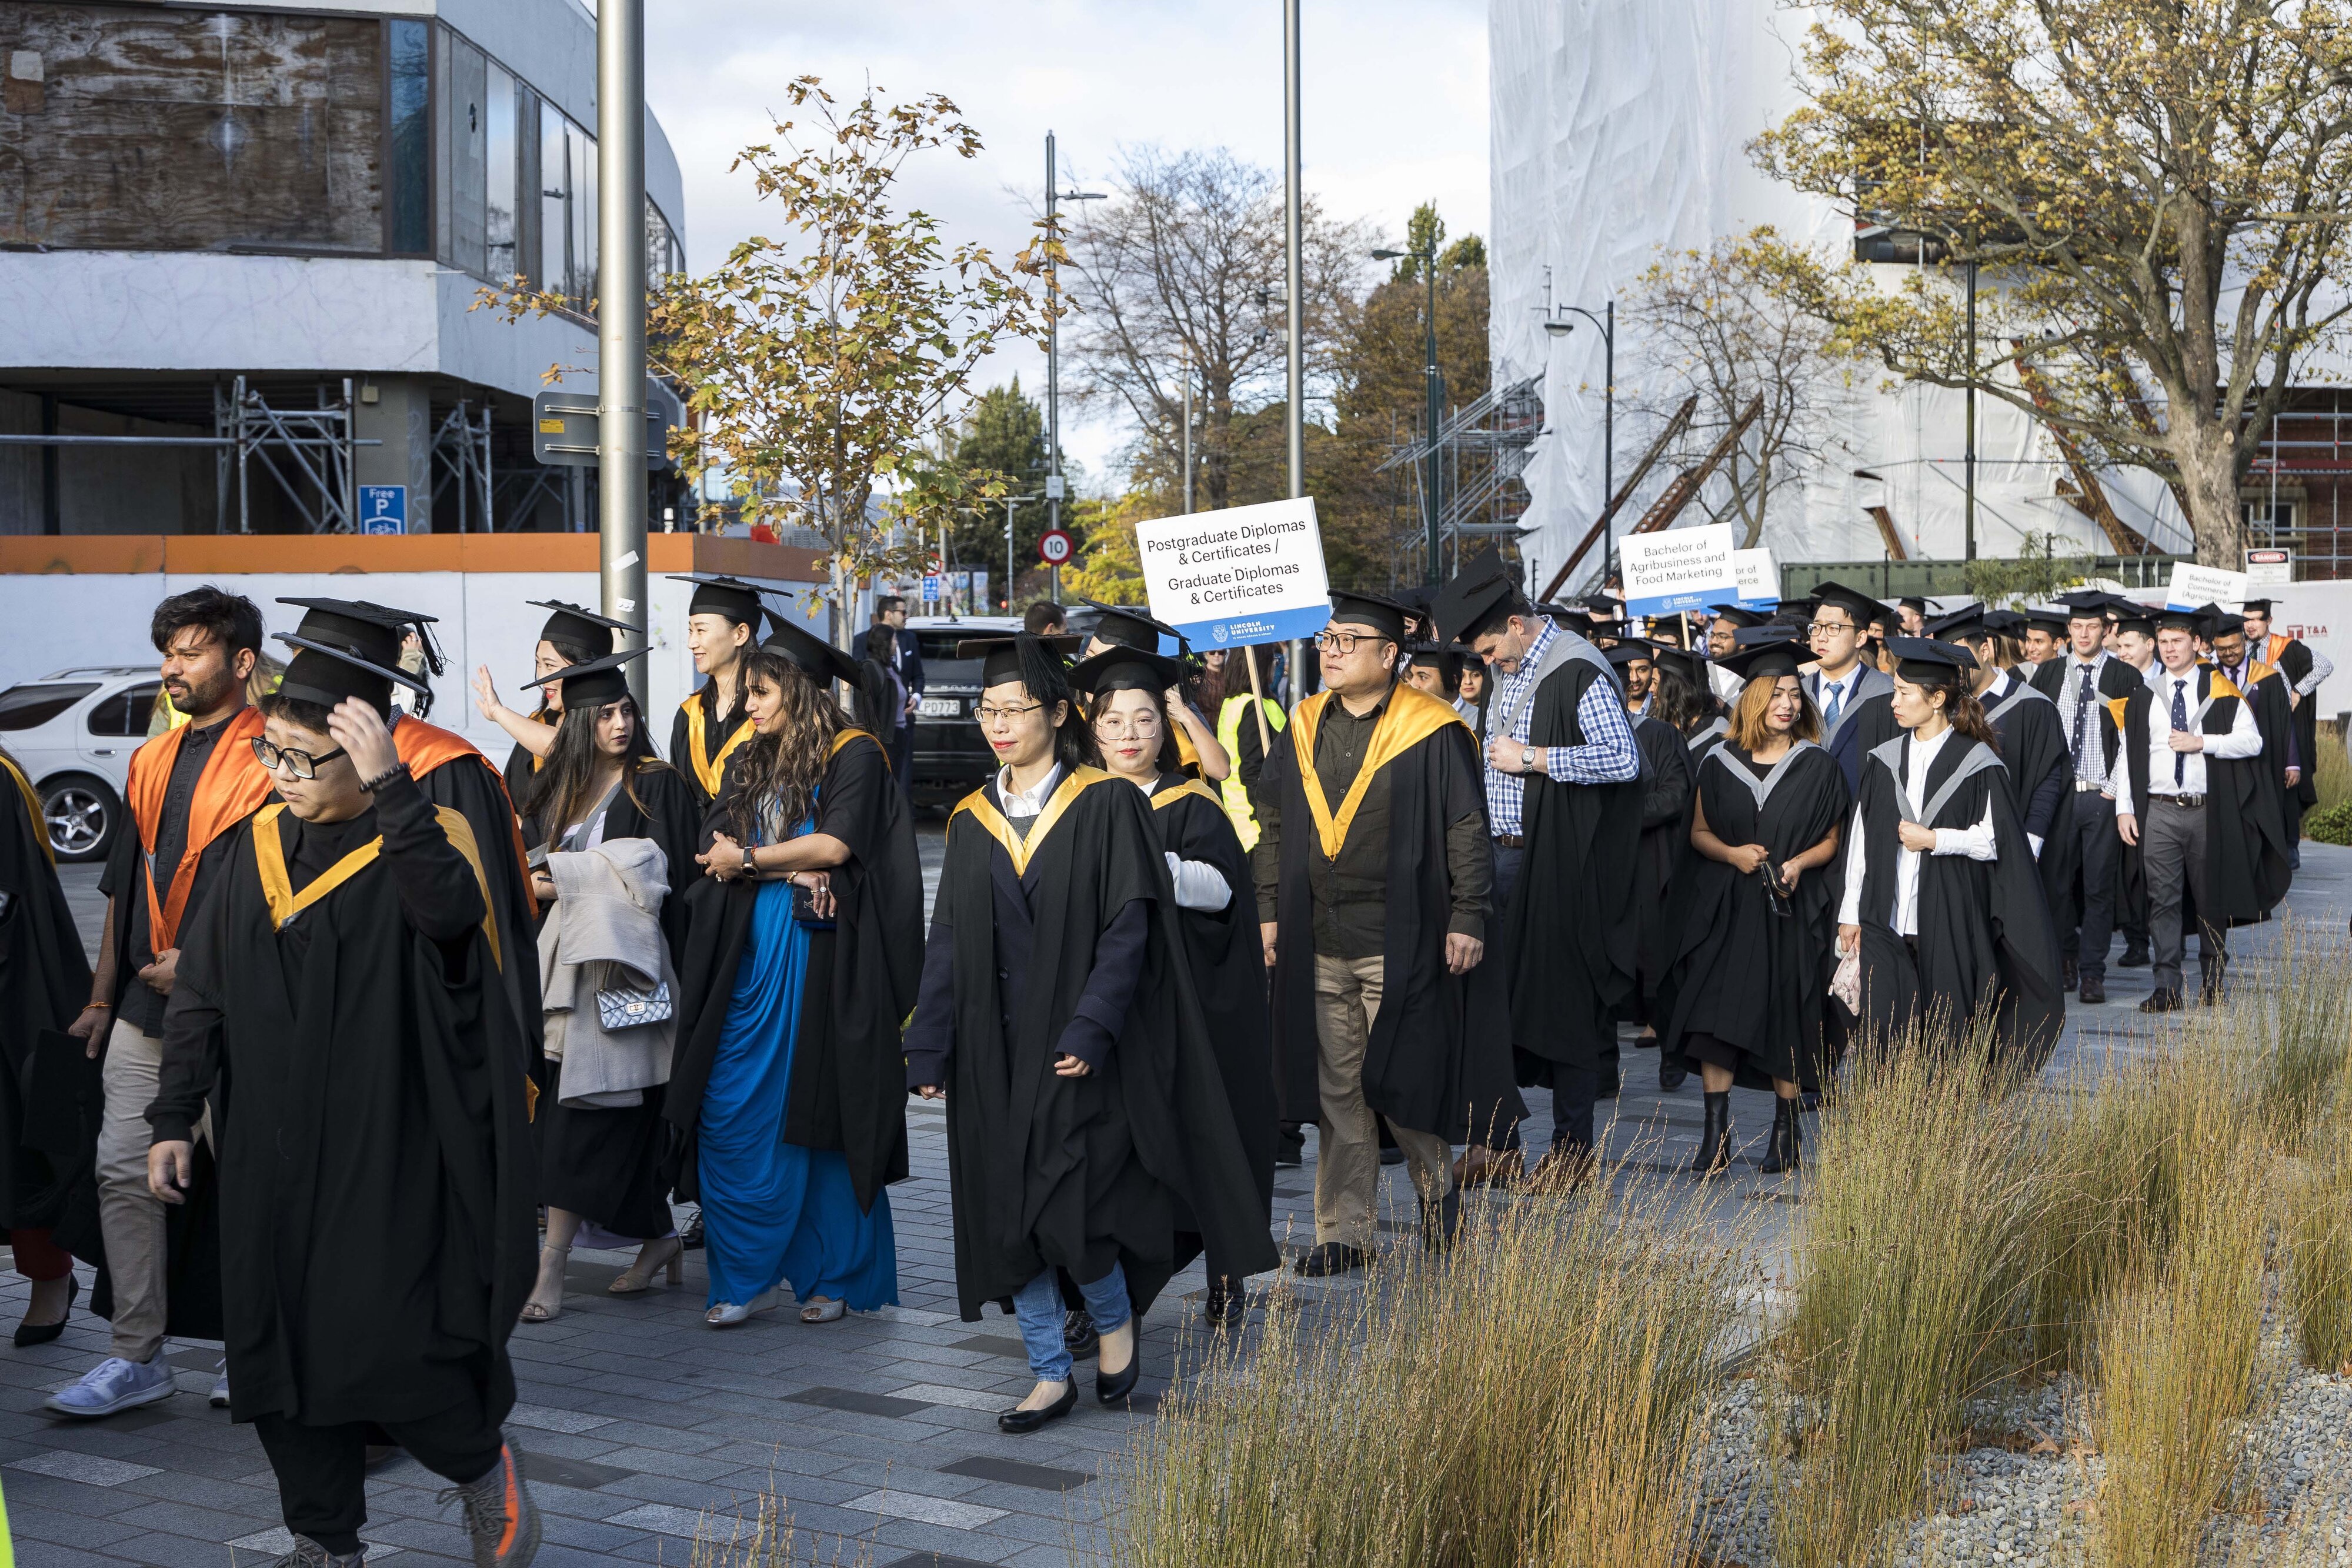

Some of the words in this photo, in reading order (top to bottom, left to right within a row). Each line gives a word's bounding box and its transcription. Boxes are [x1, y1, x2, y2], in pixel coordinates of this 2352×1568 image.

[369, 488, 395, 499] Free
[376, 499, 389, 516] P
[1147, 531, 1237, 552] Postgraduate
[1241, 521, 1306, 539] Diplomas
[1049, 541, 1063, 553] 10
[1179, 553, 1189, 565] &
[1192, 543, 1271, 563] Certificates
[1275, 538, 1279, 553] /
[1644, 543, 1692, 556] Bachelor
[1697, 539, 1706, 550] of
[1630, 557, 1702, 573] Agribusiness
[1704, 551, 1725, 563] and
[1747, 565, 1756, 573] of
[1169, 573, 1232, 590] Graduate
[1235, 563, 1299, 582] Diplomas
[1636, 573, 1663, 585] Food
[1667, 568, 1722, 582] Marketing
[2189, 574, 2221, 585] Bachelor
[1191, 592, 1200, 605] &
[1204, 583, 1283, 603] Certificates
[2188, 583, 2228, 595] Commerce
[2183, 590, 2230, 603] (Agriculture)
[1230, 621, 1260, 630] LINCOLN
[1231, 625, 1275, 635] UNIVERSITY
[2306, 625, 2327, 634] T&A
